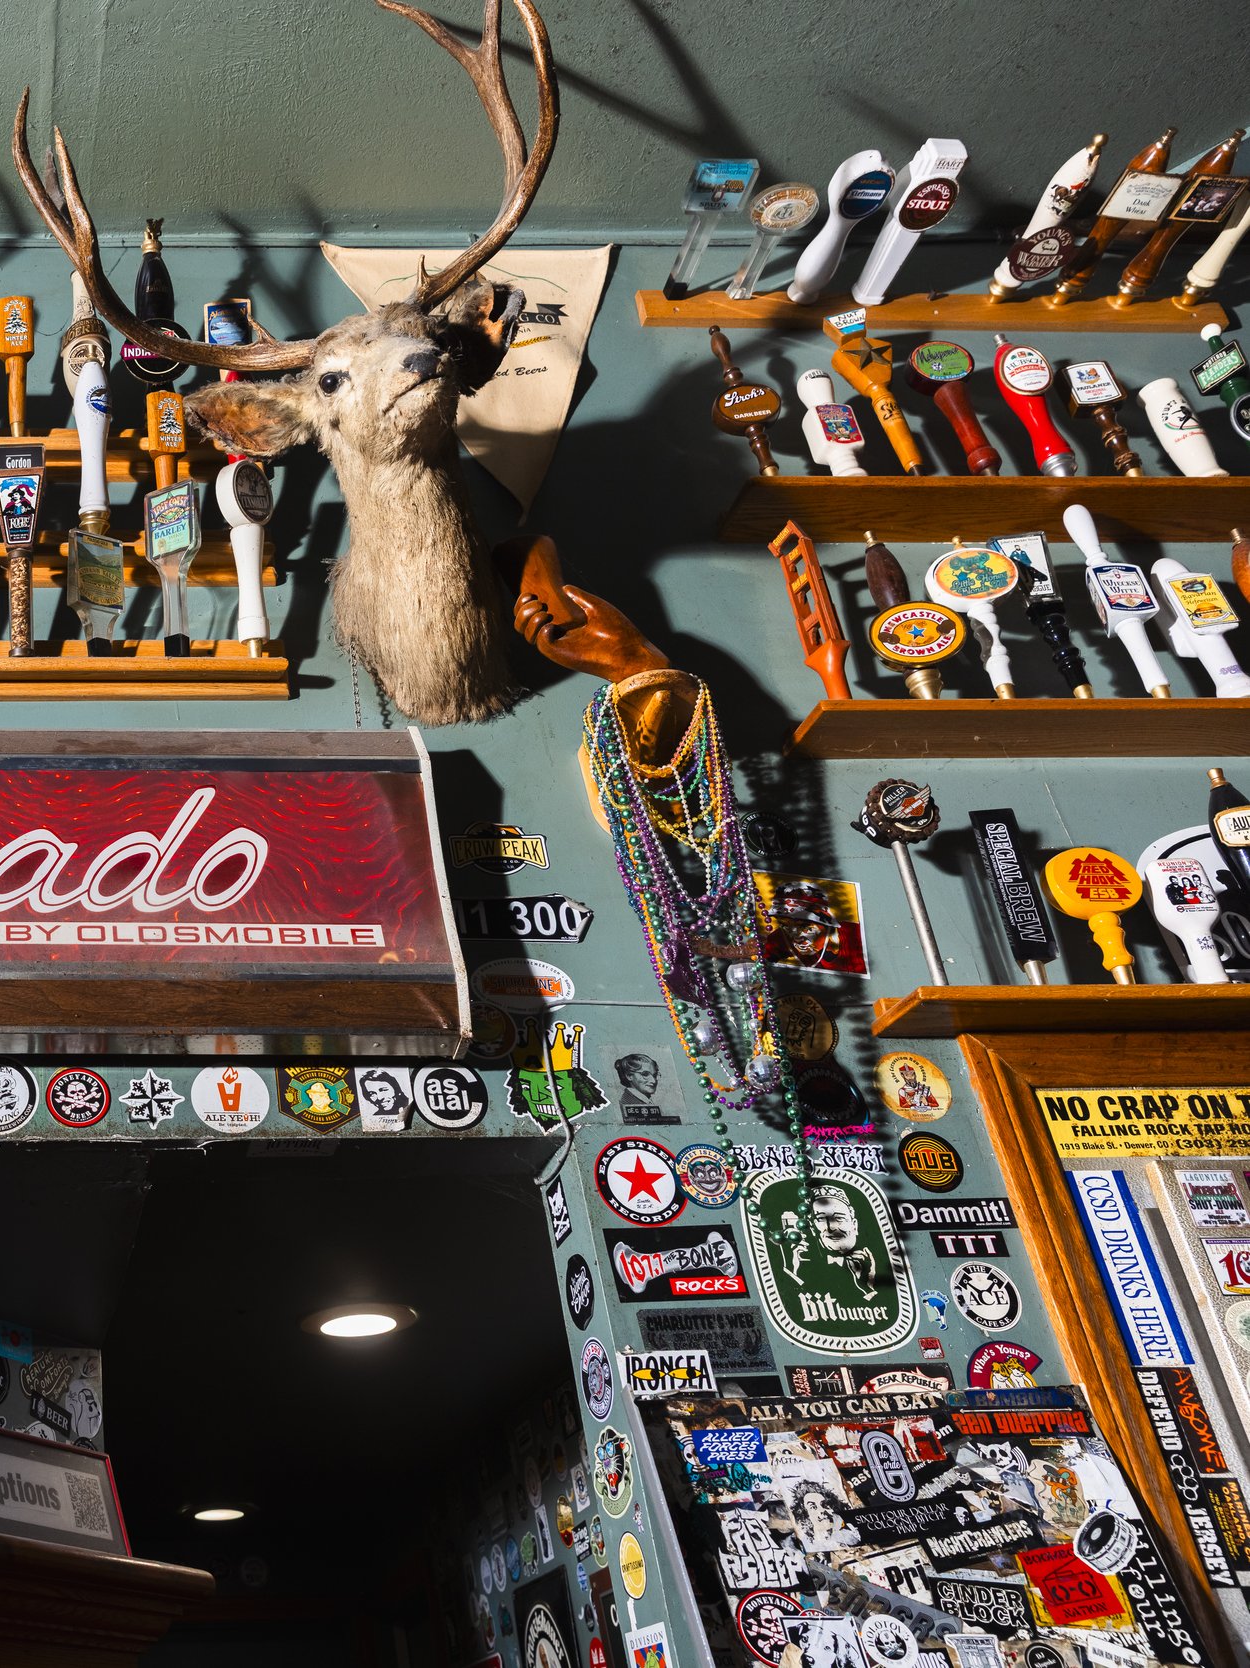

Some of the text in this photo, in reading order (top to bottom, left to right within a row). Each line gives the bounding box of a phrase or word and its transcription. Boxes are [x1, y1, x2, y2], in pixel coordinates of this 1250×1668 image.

[906, 198, 949, 210] STOUT
[834, 314, 866, 328] BROWN
[837, 311, 858, 322] NUT
[5, 335, 27, 343] WINTER
[724, 388, 766, 406] Stroh's
[160, 435, 182, 443] WINTER
[5, 456, 32, 469] Gordon
[154, 523, 186, 540] BARLEY
[1110, 586, 1140, 594] WITTE
[884, 611, 944, 633] NEWCASTLE
[893, 635, 952, 655] BROWN ALE
[884, 787, 905, 802] MILLER
[502, 840, 542, 863] PEAK
[1081, 864, 1108, 874] RED
[986, 823, 1046, 943] SPECIAL BREW
[1079, 875, 1119, 885] HOOK
[1089, 887, 1119, 899] ESB
[5, 925, 378, 946] BY OLDSMOBILE
[54, 1073, 99, 1094] BONEYARD
[69, 1110, 92, 1119] BEER
[1044, 1094, 1234, 1122] NO CRAP ON
[205, 1114, 228, 1122] ALE
[1072, 1124, 1228, 1137] FALLING ROCK TAP
[1082, 1142, 1105, 1150] Blake
[1106, 1142, 1118, 1150] St.
[1124, 1142, 1156, 1150] Denver,
[1175, 1138, 1224, 1150] (303)
[904, 1150, 955, 1171] HUB
[1184, 1174, 1228, 1182] LAGUNITAS
[695, 1190, 732, 1203] LAGER
[1189, 1200, 1244, 1210] SHUT-DOWN
[608, 1198, 680, 1223] RECORDS
[901, 1203, 1009, 1224] Dammit!
[938, 1235, 999, 1254] TTT
[619, 1251, 665, 1286] 107.7
[676, 1241, 732, 1269] BONE
[966, 1265, 987, 1274] THE
[1082, 1176, 1174, 1360] CCSD DRINKS HERE
[675, 1279, 739, 1292] ROCKS
[968, 1289, 1009, 1307] ACE
[798, 1292, 888, 1326] Bitburger
[646, 1313, 754, 1332] CHARLOTTE'S WEB
[972, 1346, 1031, 1374] What's Yours?
[877, 1374, 942, 1391] BEAR REPUBLIC
[750, 1404, 792, 1422] ALL
[794, 1400, 842, 1420] YOU
[846, 1396, 894, 1416] CAN
[896, 1392, 944, 1411] EAT
[46, 1408, 68, 1431] BEER
[702, 1432, 754, 1442] ALLIED
[699, 1441, 760, 1451] FORCES
[707, 1451, 758, 1461] PRESS
[1136, 1371, 1235, 1586] DEFEND JERSEY
[854, 1502, 950, 1524] SIXTY FOUR DOLLAR
[928, 1519, 1034, 1557] NIGHTCRAWLERS
[746, 1597, 796, 1612] BONEYARD
[937, 1581, 1025, 1611] CINDER
[940, 1601, 1030, 1628] BLOCK
[1063, 1602, 1108, 1619] NATION
[630, 1632, 663, 1649] DIVISION
